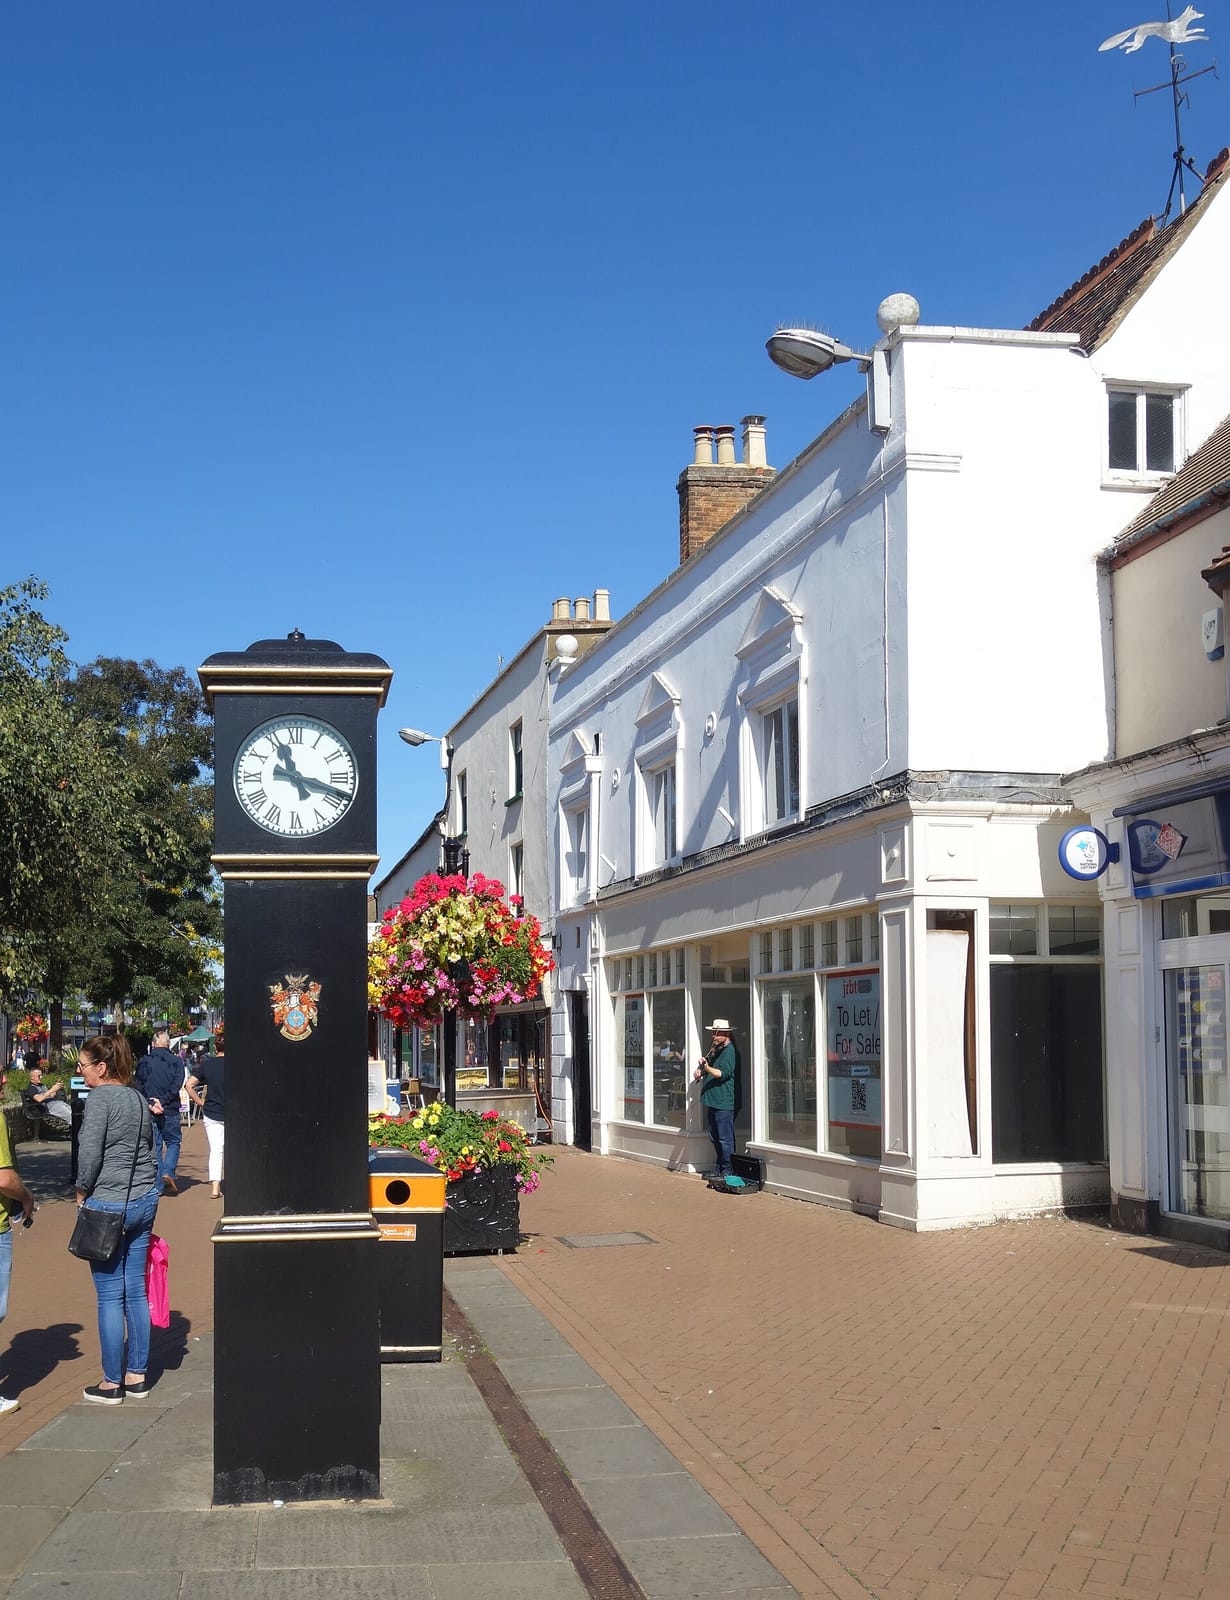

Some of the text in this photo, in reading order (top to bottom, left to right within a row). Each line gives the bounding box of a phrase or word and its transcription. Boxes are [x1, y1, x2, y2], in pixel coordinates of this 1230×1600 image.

[264, 731, 280, 753] XI
[288, 727, 304, 744] XII
[311, 734, 323, 750] I
[249, 748, 269, 765] X
[324, 749, 344, 765] II
[243, 771, 262, 784] IX
[330, 771, 349, 785] III
[247, 787, 268, 813] VIII
[321, 790, 343, 810] III
[263, 803, 281, 826] VII
[289, 811, 304, 829] VI
[313, 808, 327, 825] V
[837, 1006, 849, 1027] To
[853, 1005, 871, 1026] Let
[835, 1032, 880, 1055] For Sale
